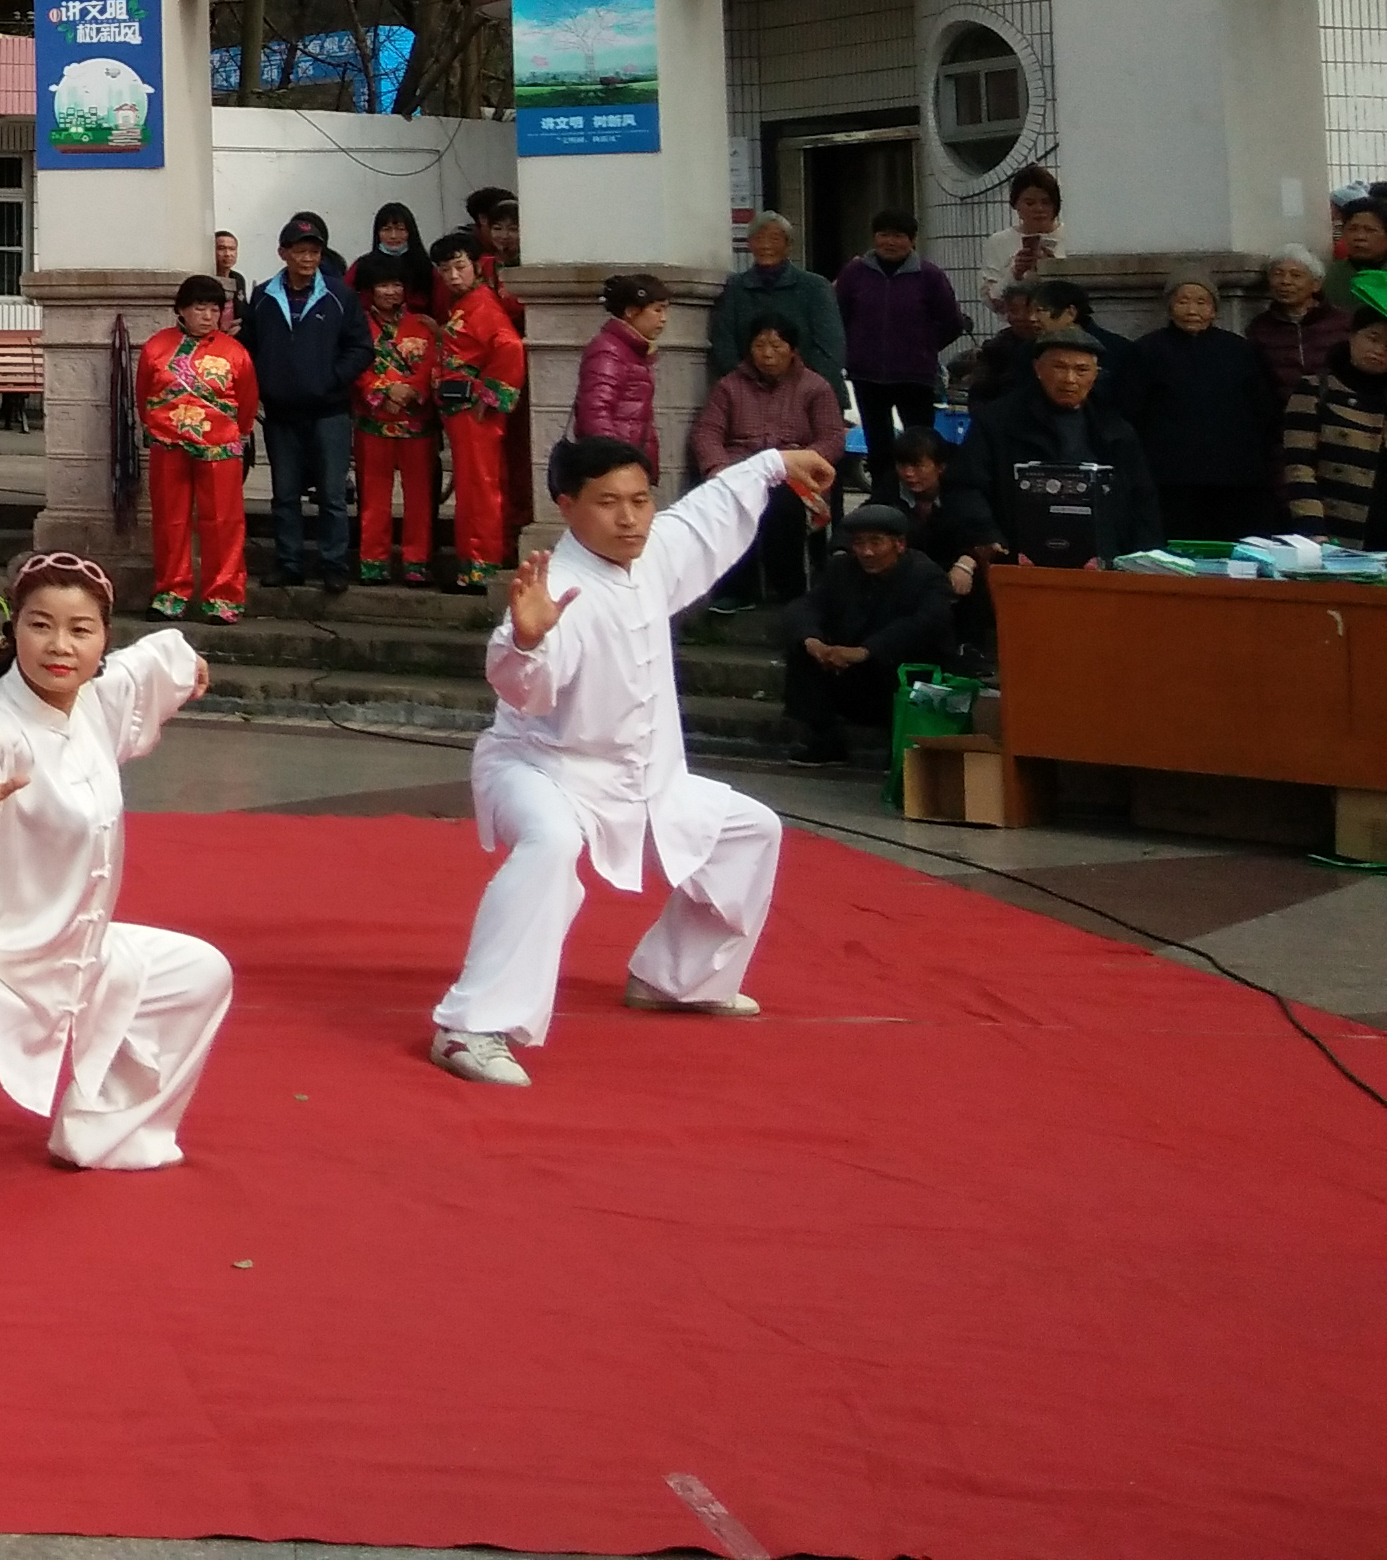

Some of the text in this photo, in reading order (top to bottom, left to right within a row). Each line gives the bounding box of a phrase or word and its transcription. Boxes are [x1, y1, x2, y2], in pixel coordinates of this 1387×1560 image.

[61, 0, 129, 22] 讲文明
[76, 22, 143, 45] 树新风
